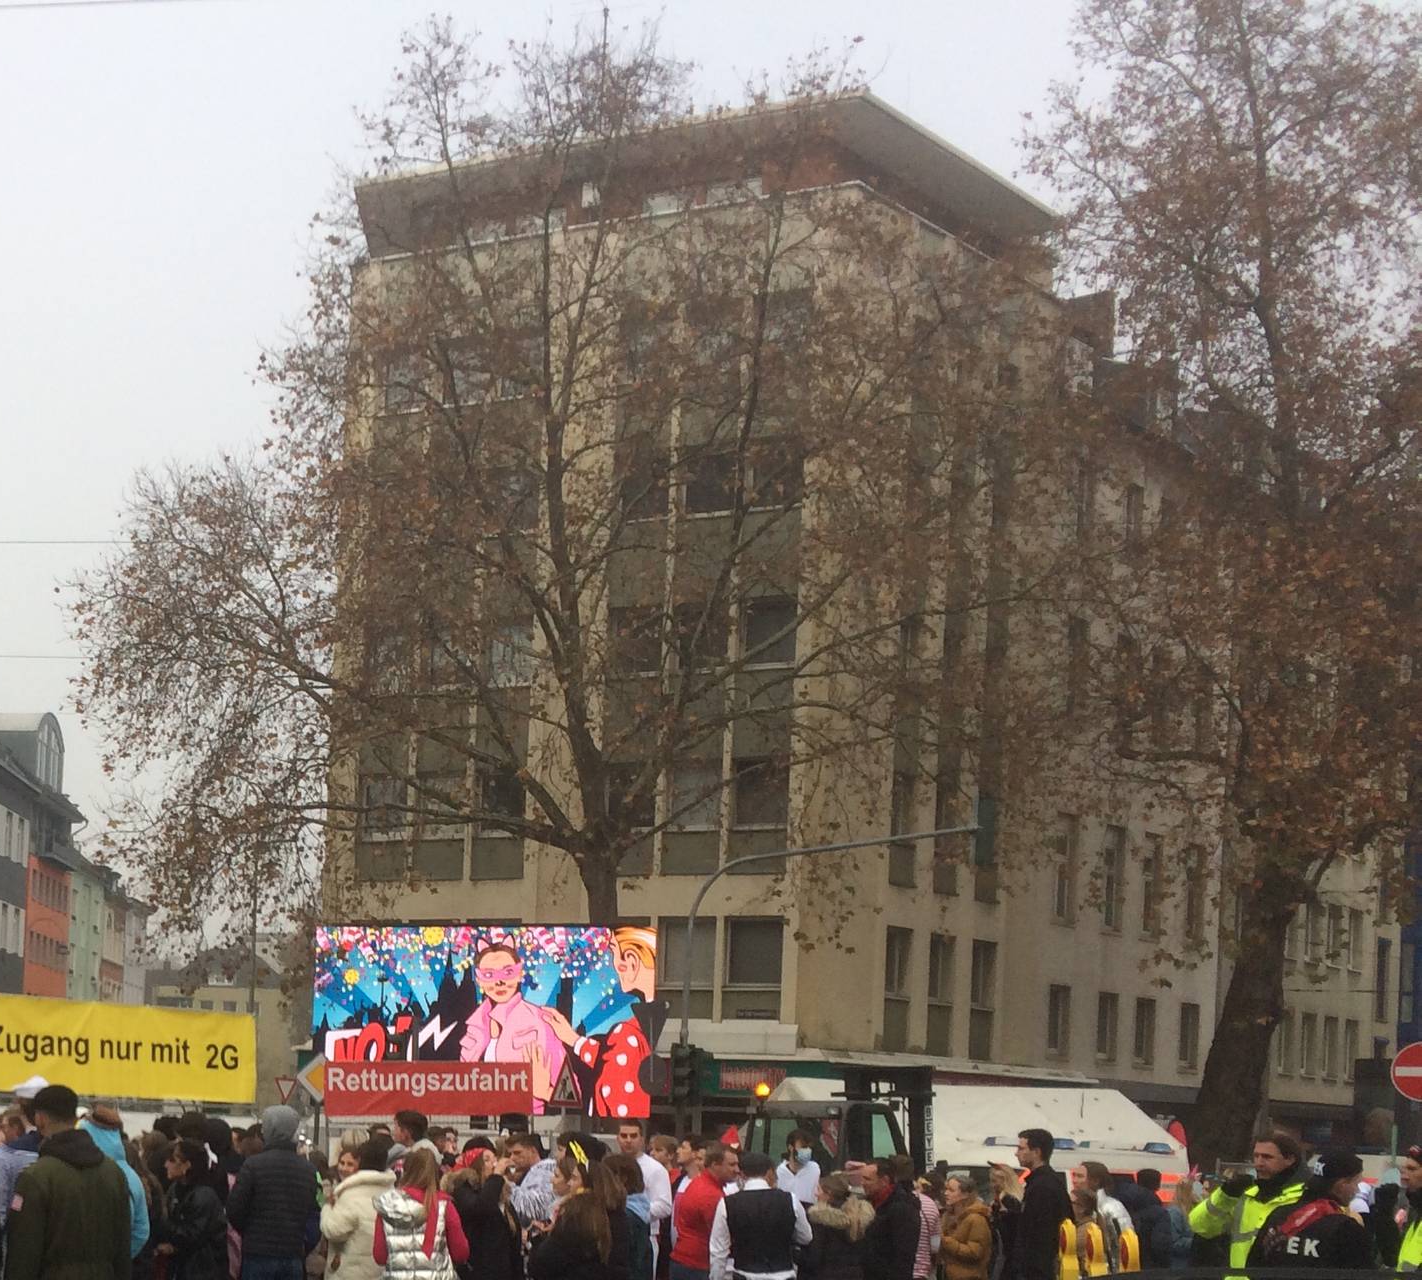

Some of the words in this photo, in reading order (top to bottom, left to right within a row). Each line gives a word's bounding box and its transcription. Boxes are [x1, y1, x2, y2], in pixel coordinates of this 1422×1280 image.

[100, 1037, 143, 1061] nur
[151, 1037, 191, 1065] mit
[205, 1043, 239, 1070] 2G
[328, 1067, 529, 1098] Rettungszufahrt
